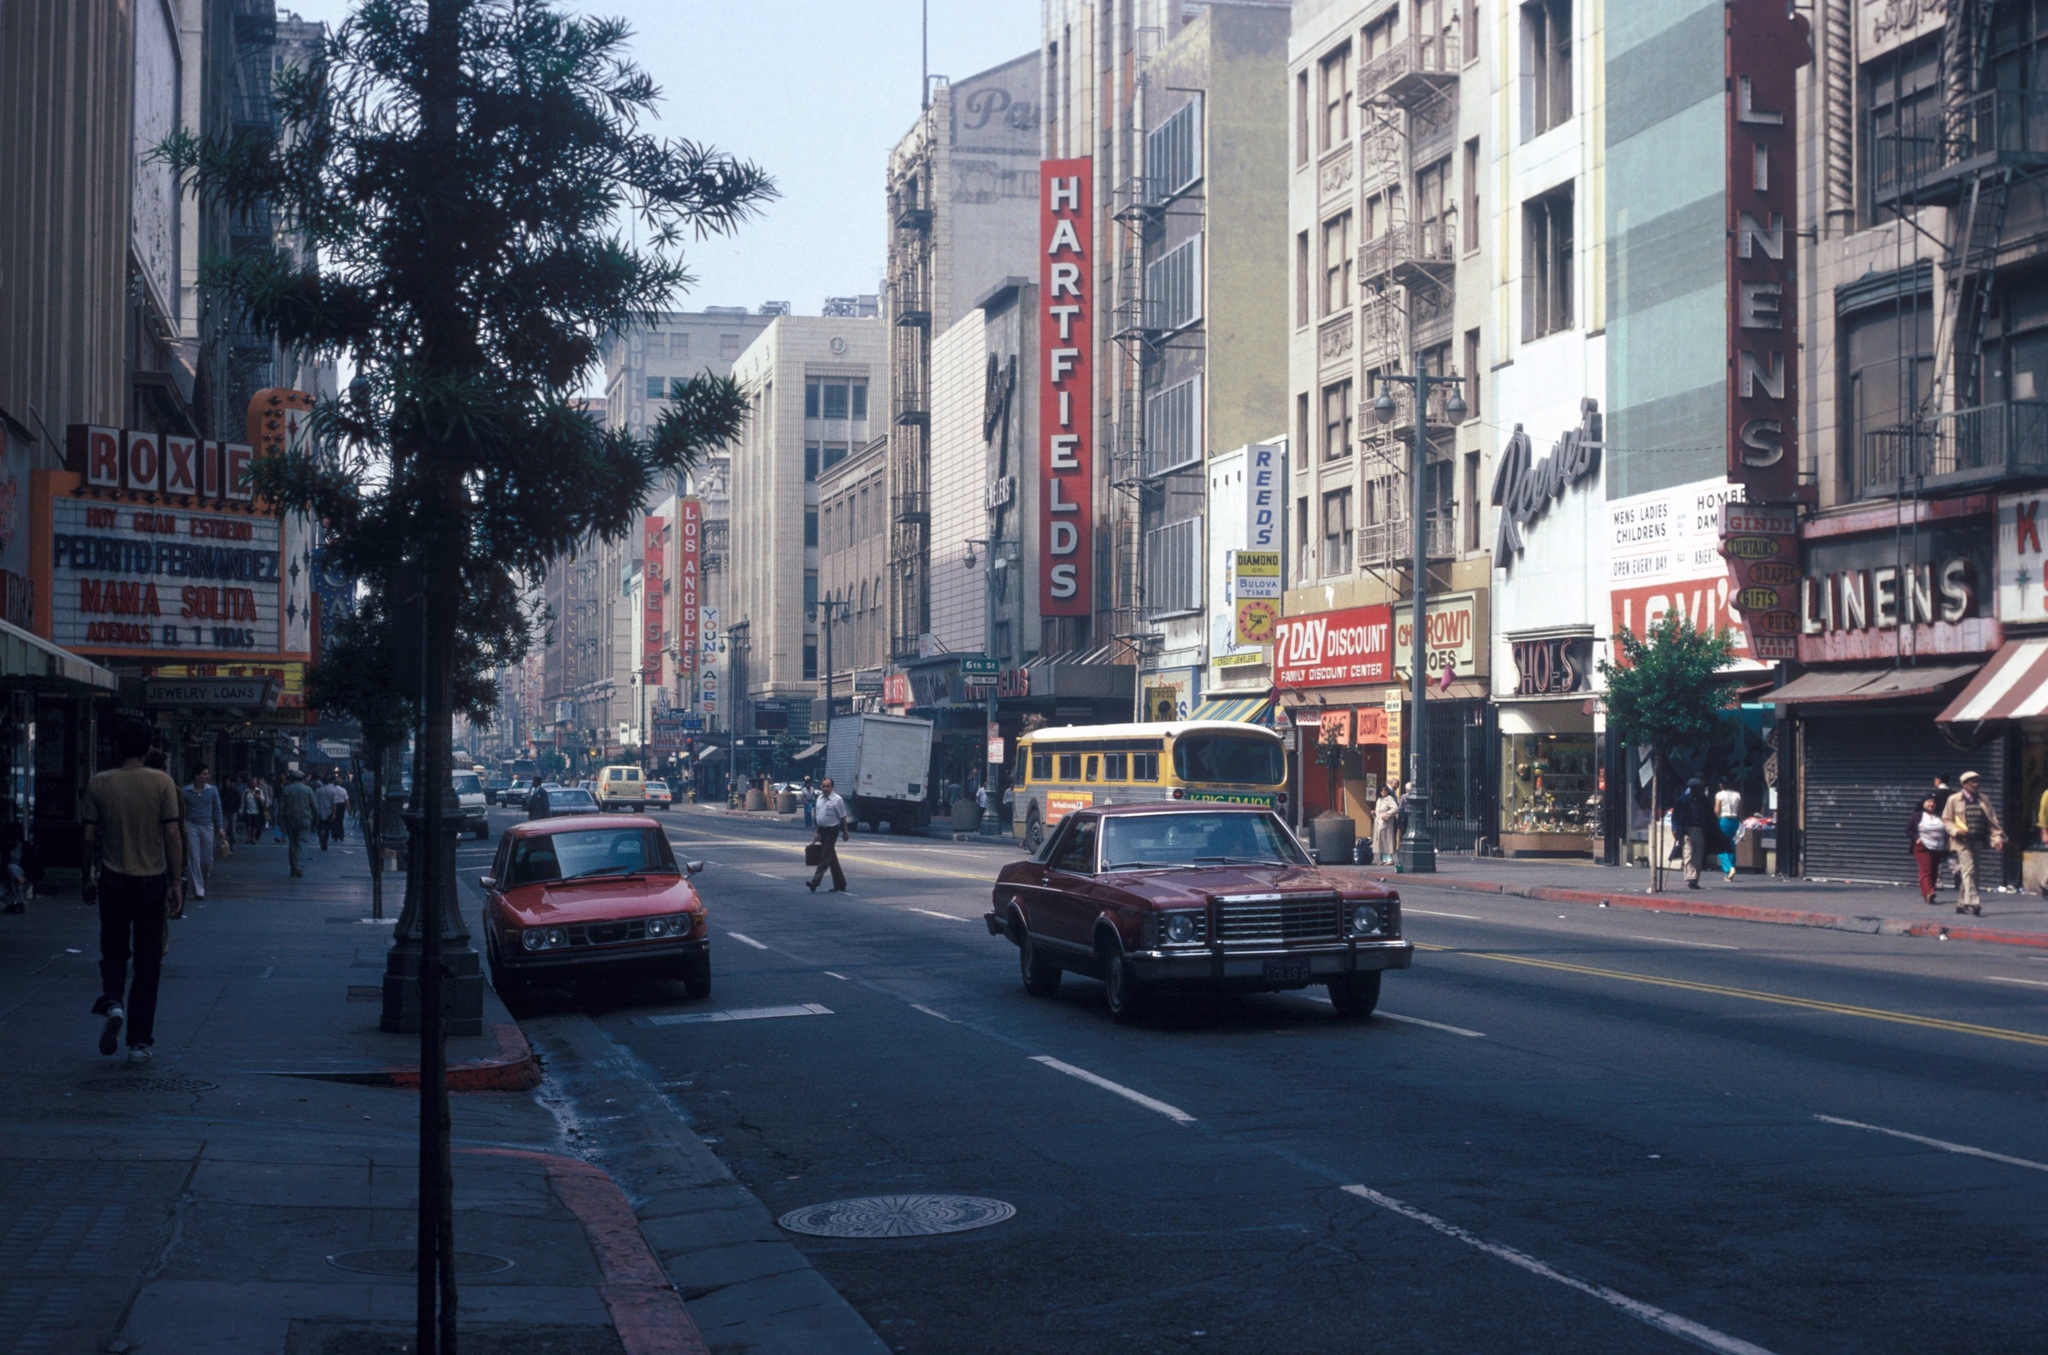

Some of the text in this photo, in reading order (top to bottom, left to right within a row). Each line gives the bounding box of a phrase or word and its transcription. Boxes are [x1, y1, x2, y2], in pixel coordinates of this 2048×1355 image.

[1736, 75, 1784, 467] LINENS
[1048, 176, 1082, 598] HARTFIELDS
[90, 432, 251, 498] ROXIE
[1255, 451, 1272, 545] REED'S
[86, 507, 253, 541] HOY GRAN ESTRENO
[1613, 503, 1668, 526] MENS LADIES
[1730, 518, 1792, 531] GINDI
[1616, 525, 1667, 544] CHILDRENS
[54, 533, 281, 583] PEDRITO FERNANDEZ
[1731, 539, 1774, 556] CURTAINS
[1237, 555, 1279, 566] DIAMOND
[1613, 554, 1668, 577] OPEN EVERY DAY
[1240, 579, 1278, 589] BULOVA
[1756, 567, 1796, 582] DRAPES
[683, 506, 697, 670] LOS ANGELES
[1742, 592, 1774, 607] GIFTS
[1801, 557, 1973, 634] LINENS
[80, 578, 258, 622] MAMA SOLITA
[647, 531, 662, 671] KRESS
[86, 621, 151, 643] ADEMAS
[164, 625, 181, 645] EL
[213, 627, 255, 648] VIDAS
[1768, 615, 1796, 631] RUGS
[1275, 623, 1290, 667] 7
[1290, 618, 1328, 660] DAY
[1327, 623, 1388, 657] DISCOUNT
[1758, 646, 1794, 657] CREDIT
[1760, 638, 1791, 647] EASY
[703, 610, 717, 712] YOUNG AGES
[966, 660, 982, 669] 6th
[1281, 663, 1382, 682] FAMILY DISCOUNT CENTER
[1511, 637, 1574, 695] SHOES
[149, 686, 255, 700] JEWELRY LOANS
[1152, 689, 1174, 699] CROSS
